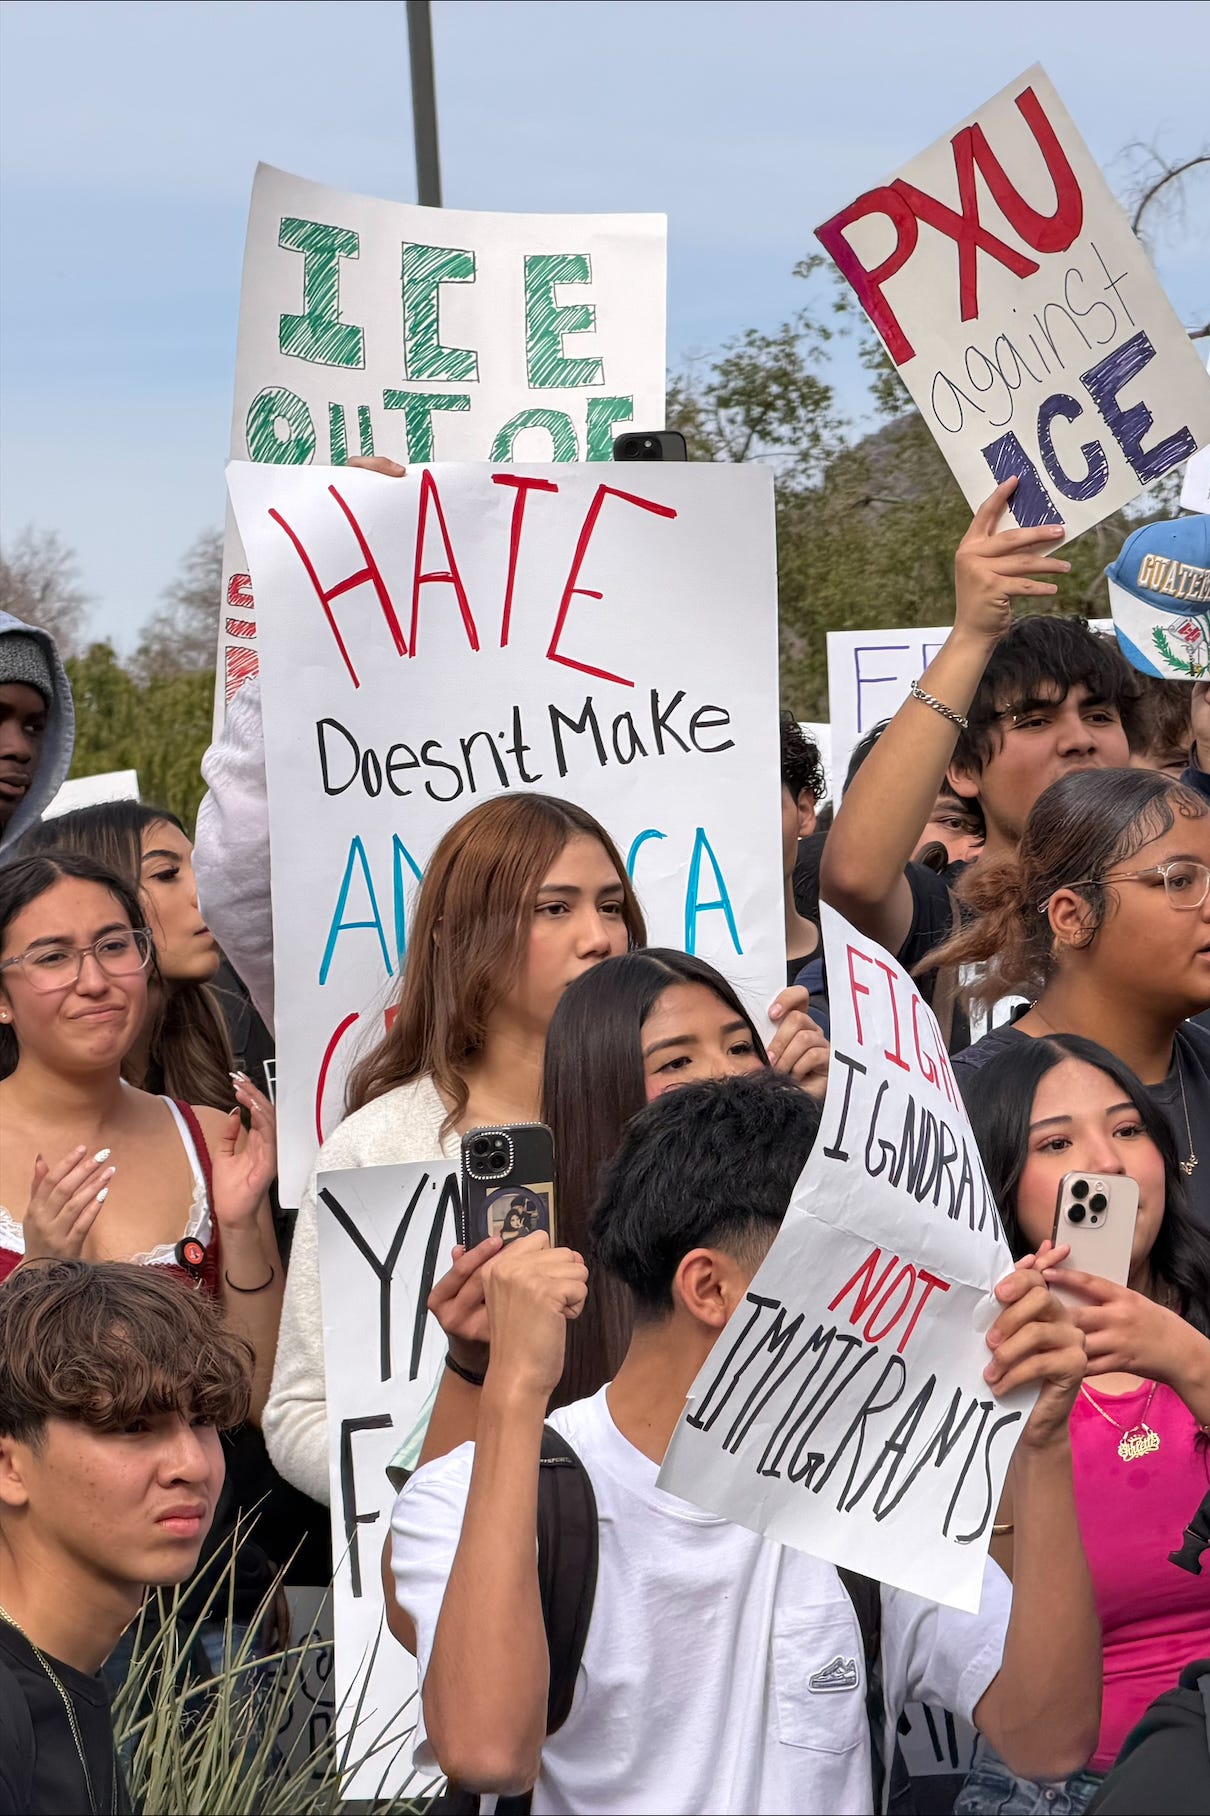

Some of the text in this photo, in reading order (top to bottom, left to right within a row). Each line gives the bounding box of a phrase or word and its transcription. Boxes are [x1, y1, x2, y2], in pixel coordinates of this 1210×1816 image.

[278, 216, 605, 390] ICE
[814, 85, 1084, 367] PXU
[931, 242, 1136, 433] against
[980, 329, 1198, 528] ICE
[268, 468, 678, 688] HATE
[315, 688, 736, 802] Doesn't Make
[827, 1247, 952, 1354] NOT
[686, 1291, 1022, 1544] IMMIGRANTS
